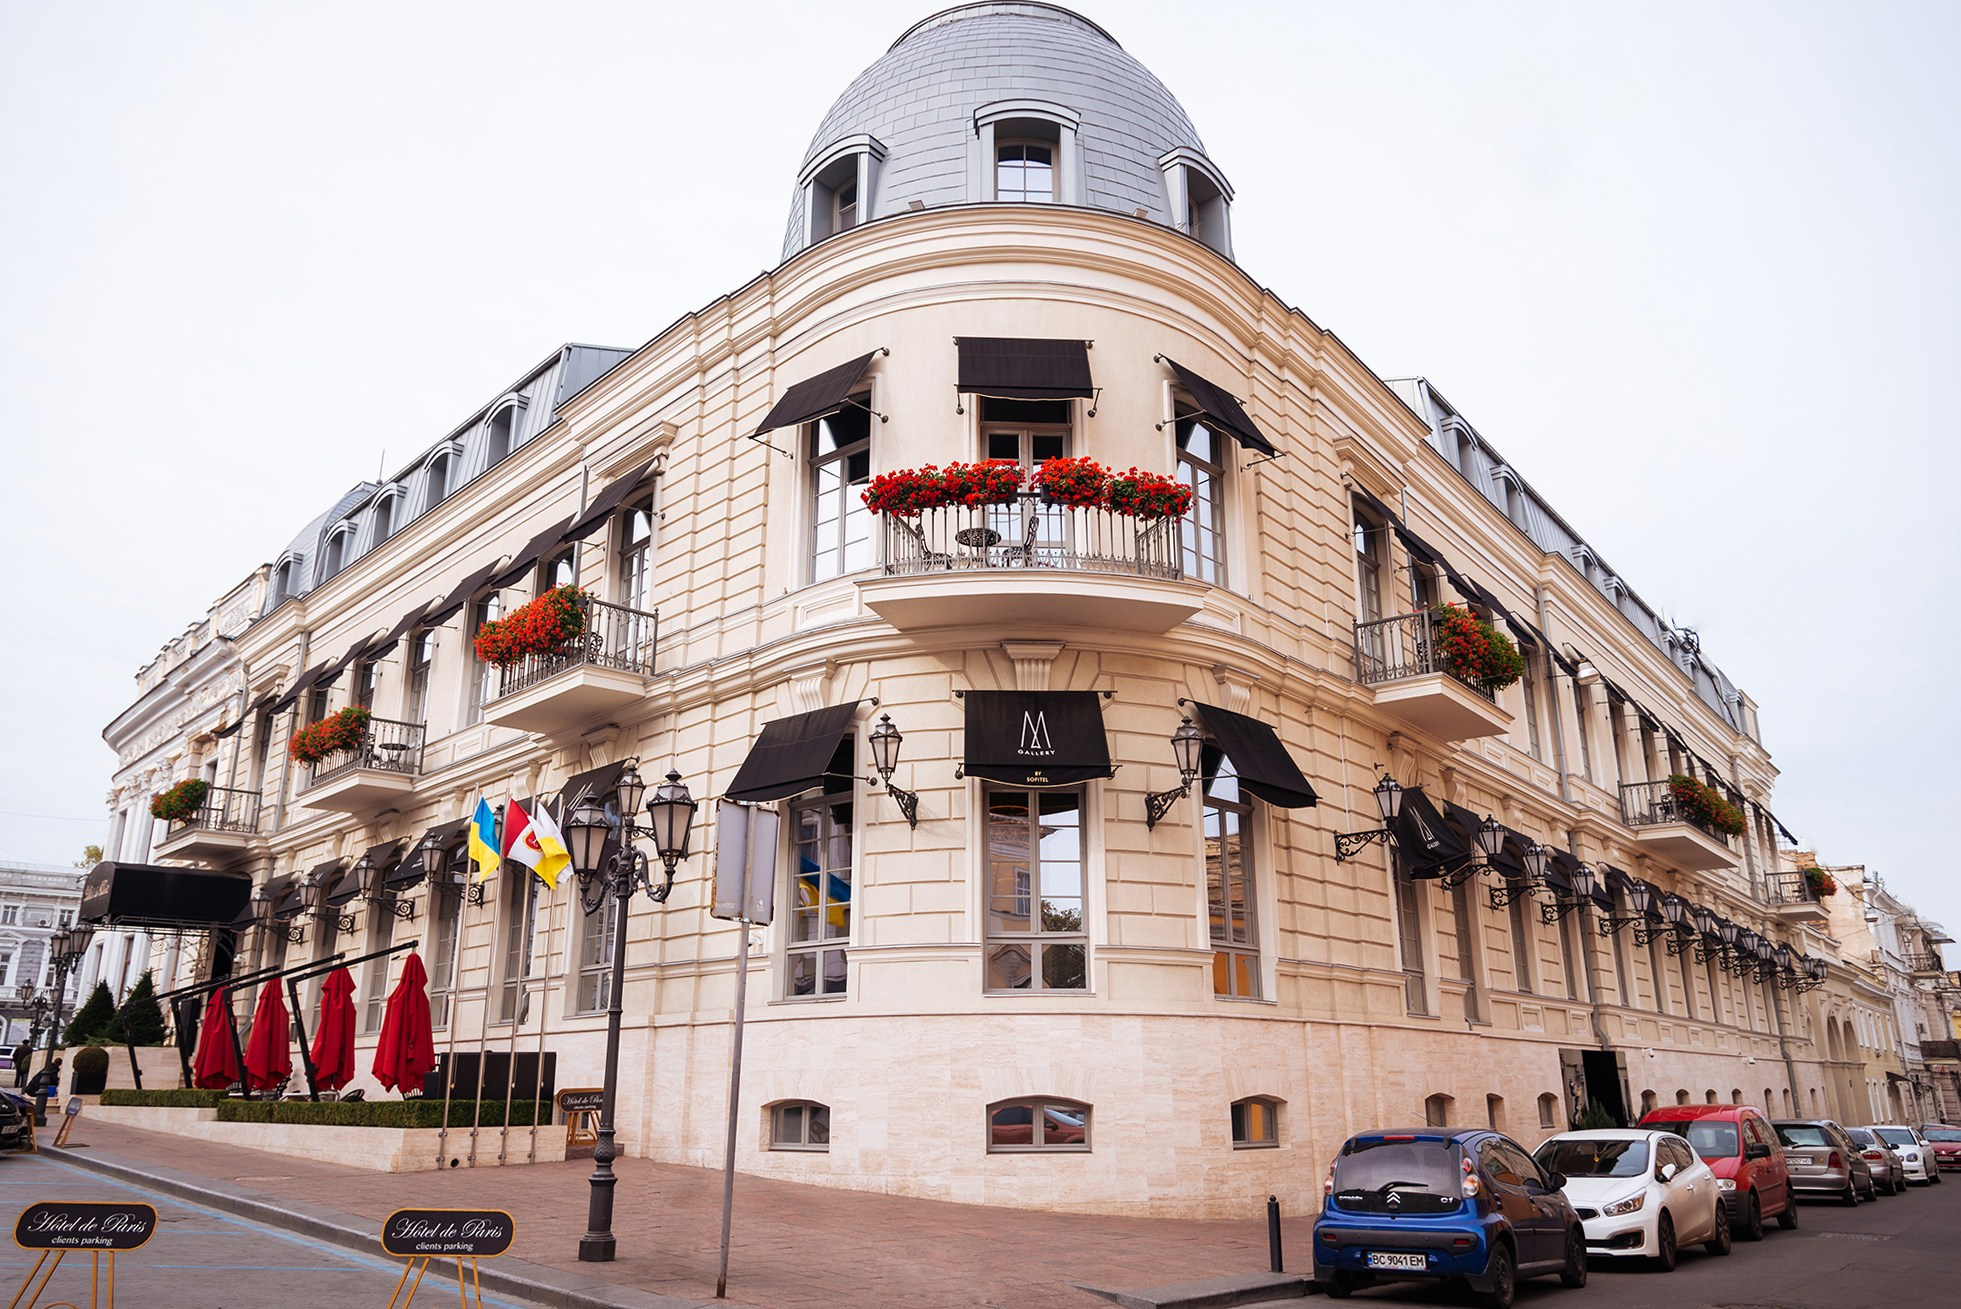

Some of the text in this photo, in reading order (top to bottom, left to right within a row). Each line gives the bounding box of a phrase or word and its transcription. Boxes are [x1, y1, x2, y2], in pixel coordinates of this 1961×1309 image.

[27, 1210, 147, 1233] Hôtel de Paris
[391, 1217, 503, 1239] Hôtel de Paris
[51, 1235, 114, 1246] clients parking
[415, 1242, 474, 1251] clients parking
[1372, 1255, 1424, 1266] BC 9041 EM
